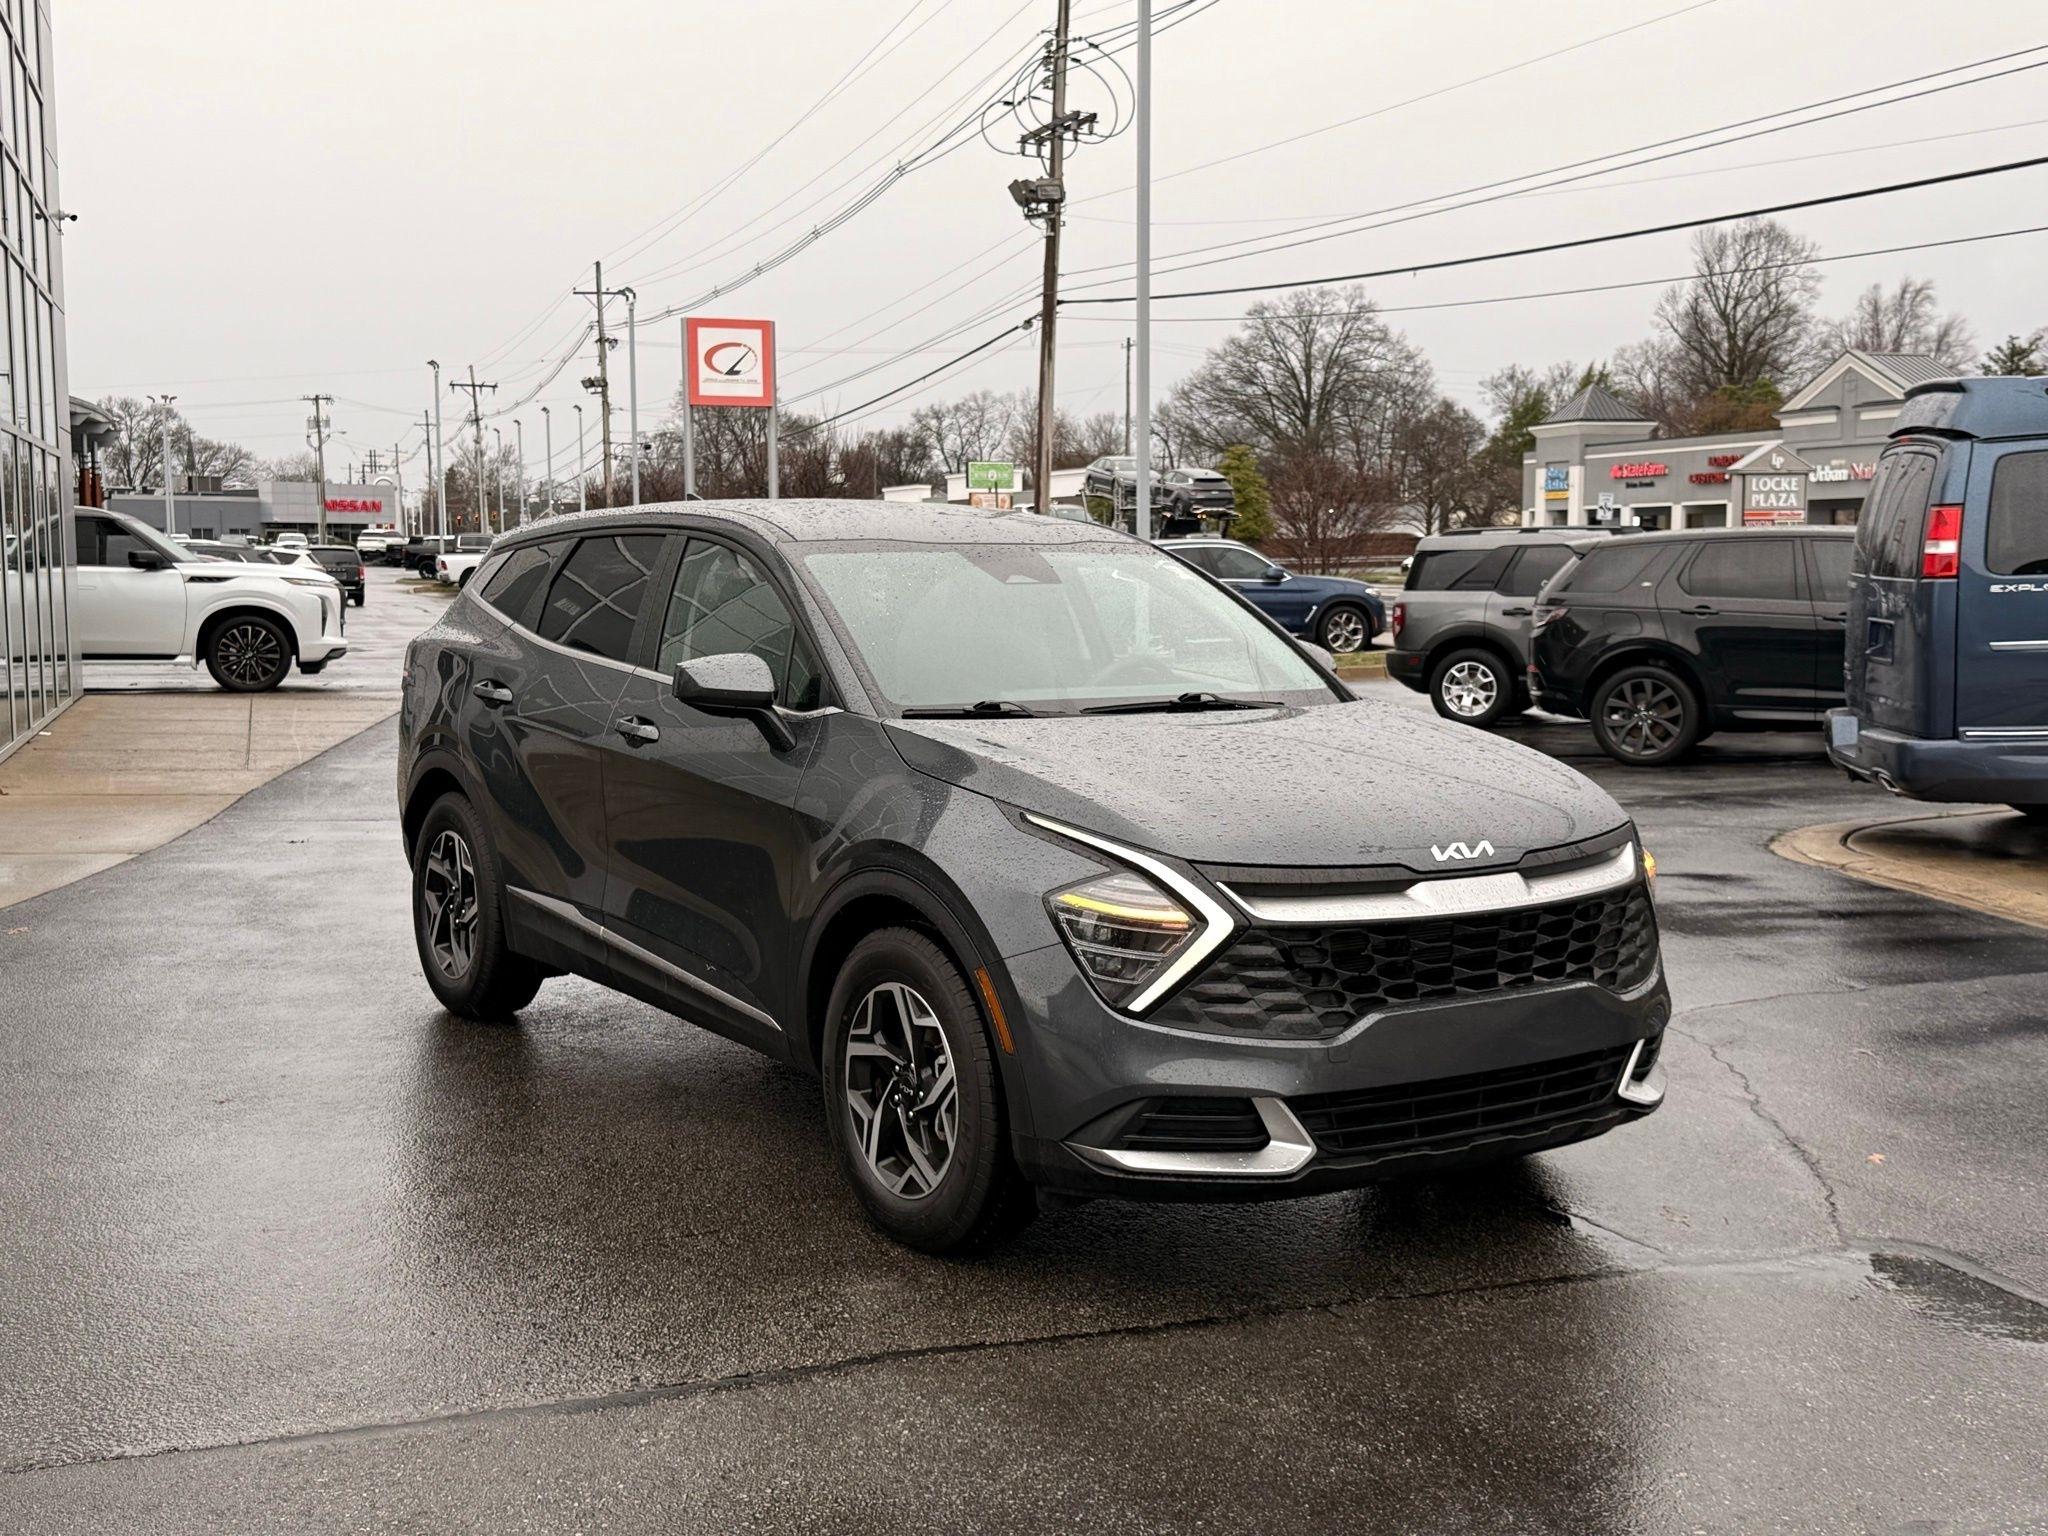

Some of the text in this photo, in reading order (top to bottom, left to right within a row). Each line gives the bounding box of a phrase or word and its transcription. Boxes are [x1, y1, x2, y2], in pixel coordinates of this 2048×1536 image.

[1751, 477, 1799, 491] LOCKE
[324, 499, 382, 513] NISSAN
[1751, 492, 1797, 507] PLAZA
[1430, 839, 1495, 862] KIA
